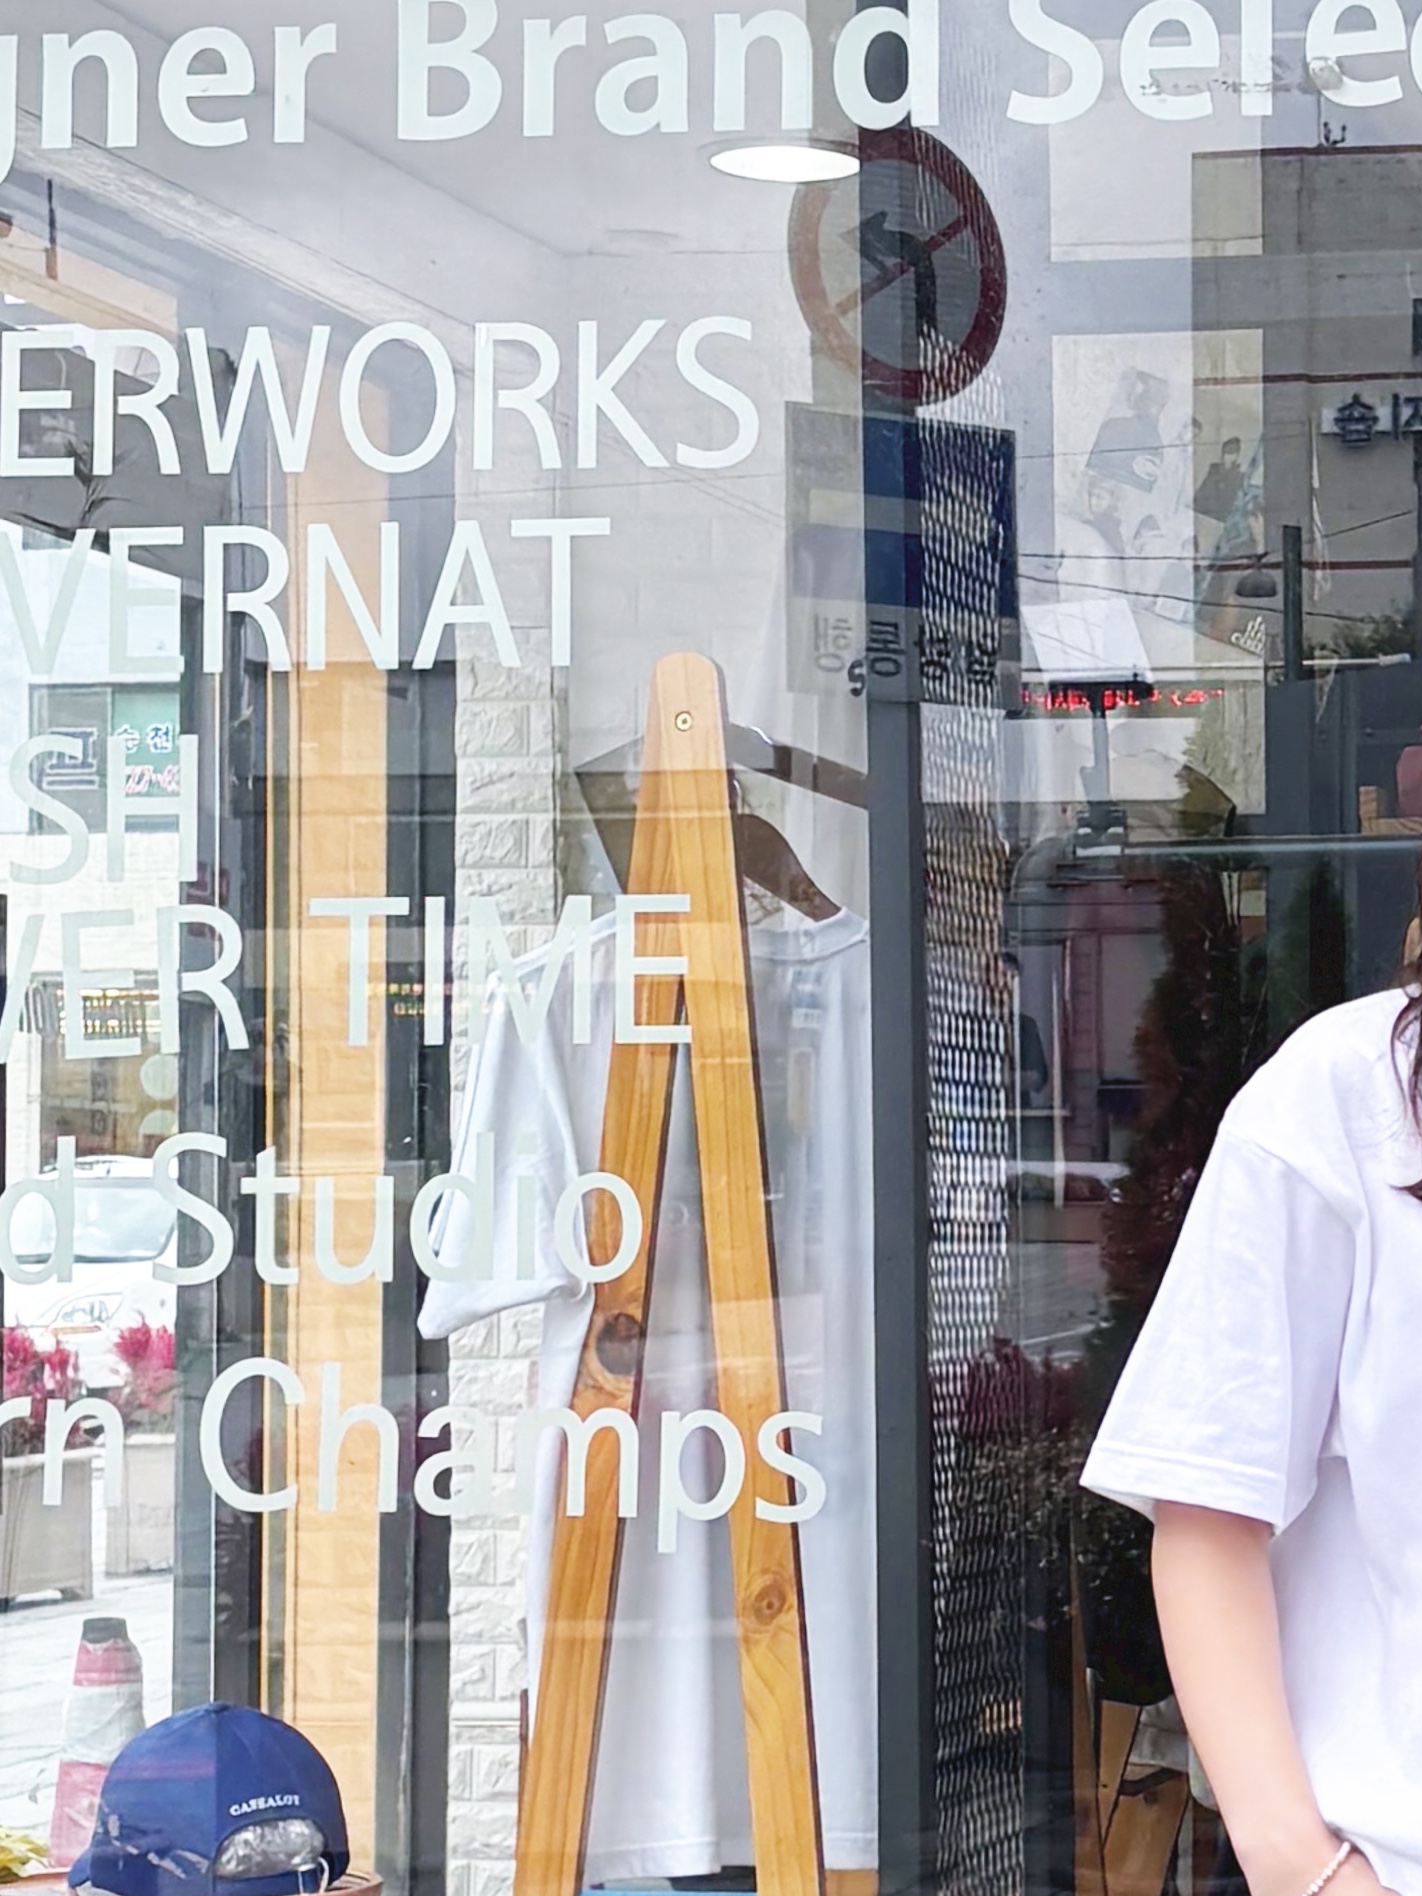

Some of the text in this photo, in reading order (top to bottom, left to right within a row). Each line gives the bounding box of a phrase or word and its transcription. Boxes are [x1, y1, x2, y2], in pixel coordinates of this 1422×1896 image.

[0, 24, 336, 186] ner
[397, 0, 940, 142] Brand
[0, 517, 611, 674] VERNAT
[309, 893, 694, 1048] TIME
[152, 1131, 644, 1285] Studio
[200, 1356, 827, 1554] Champs
